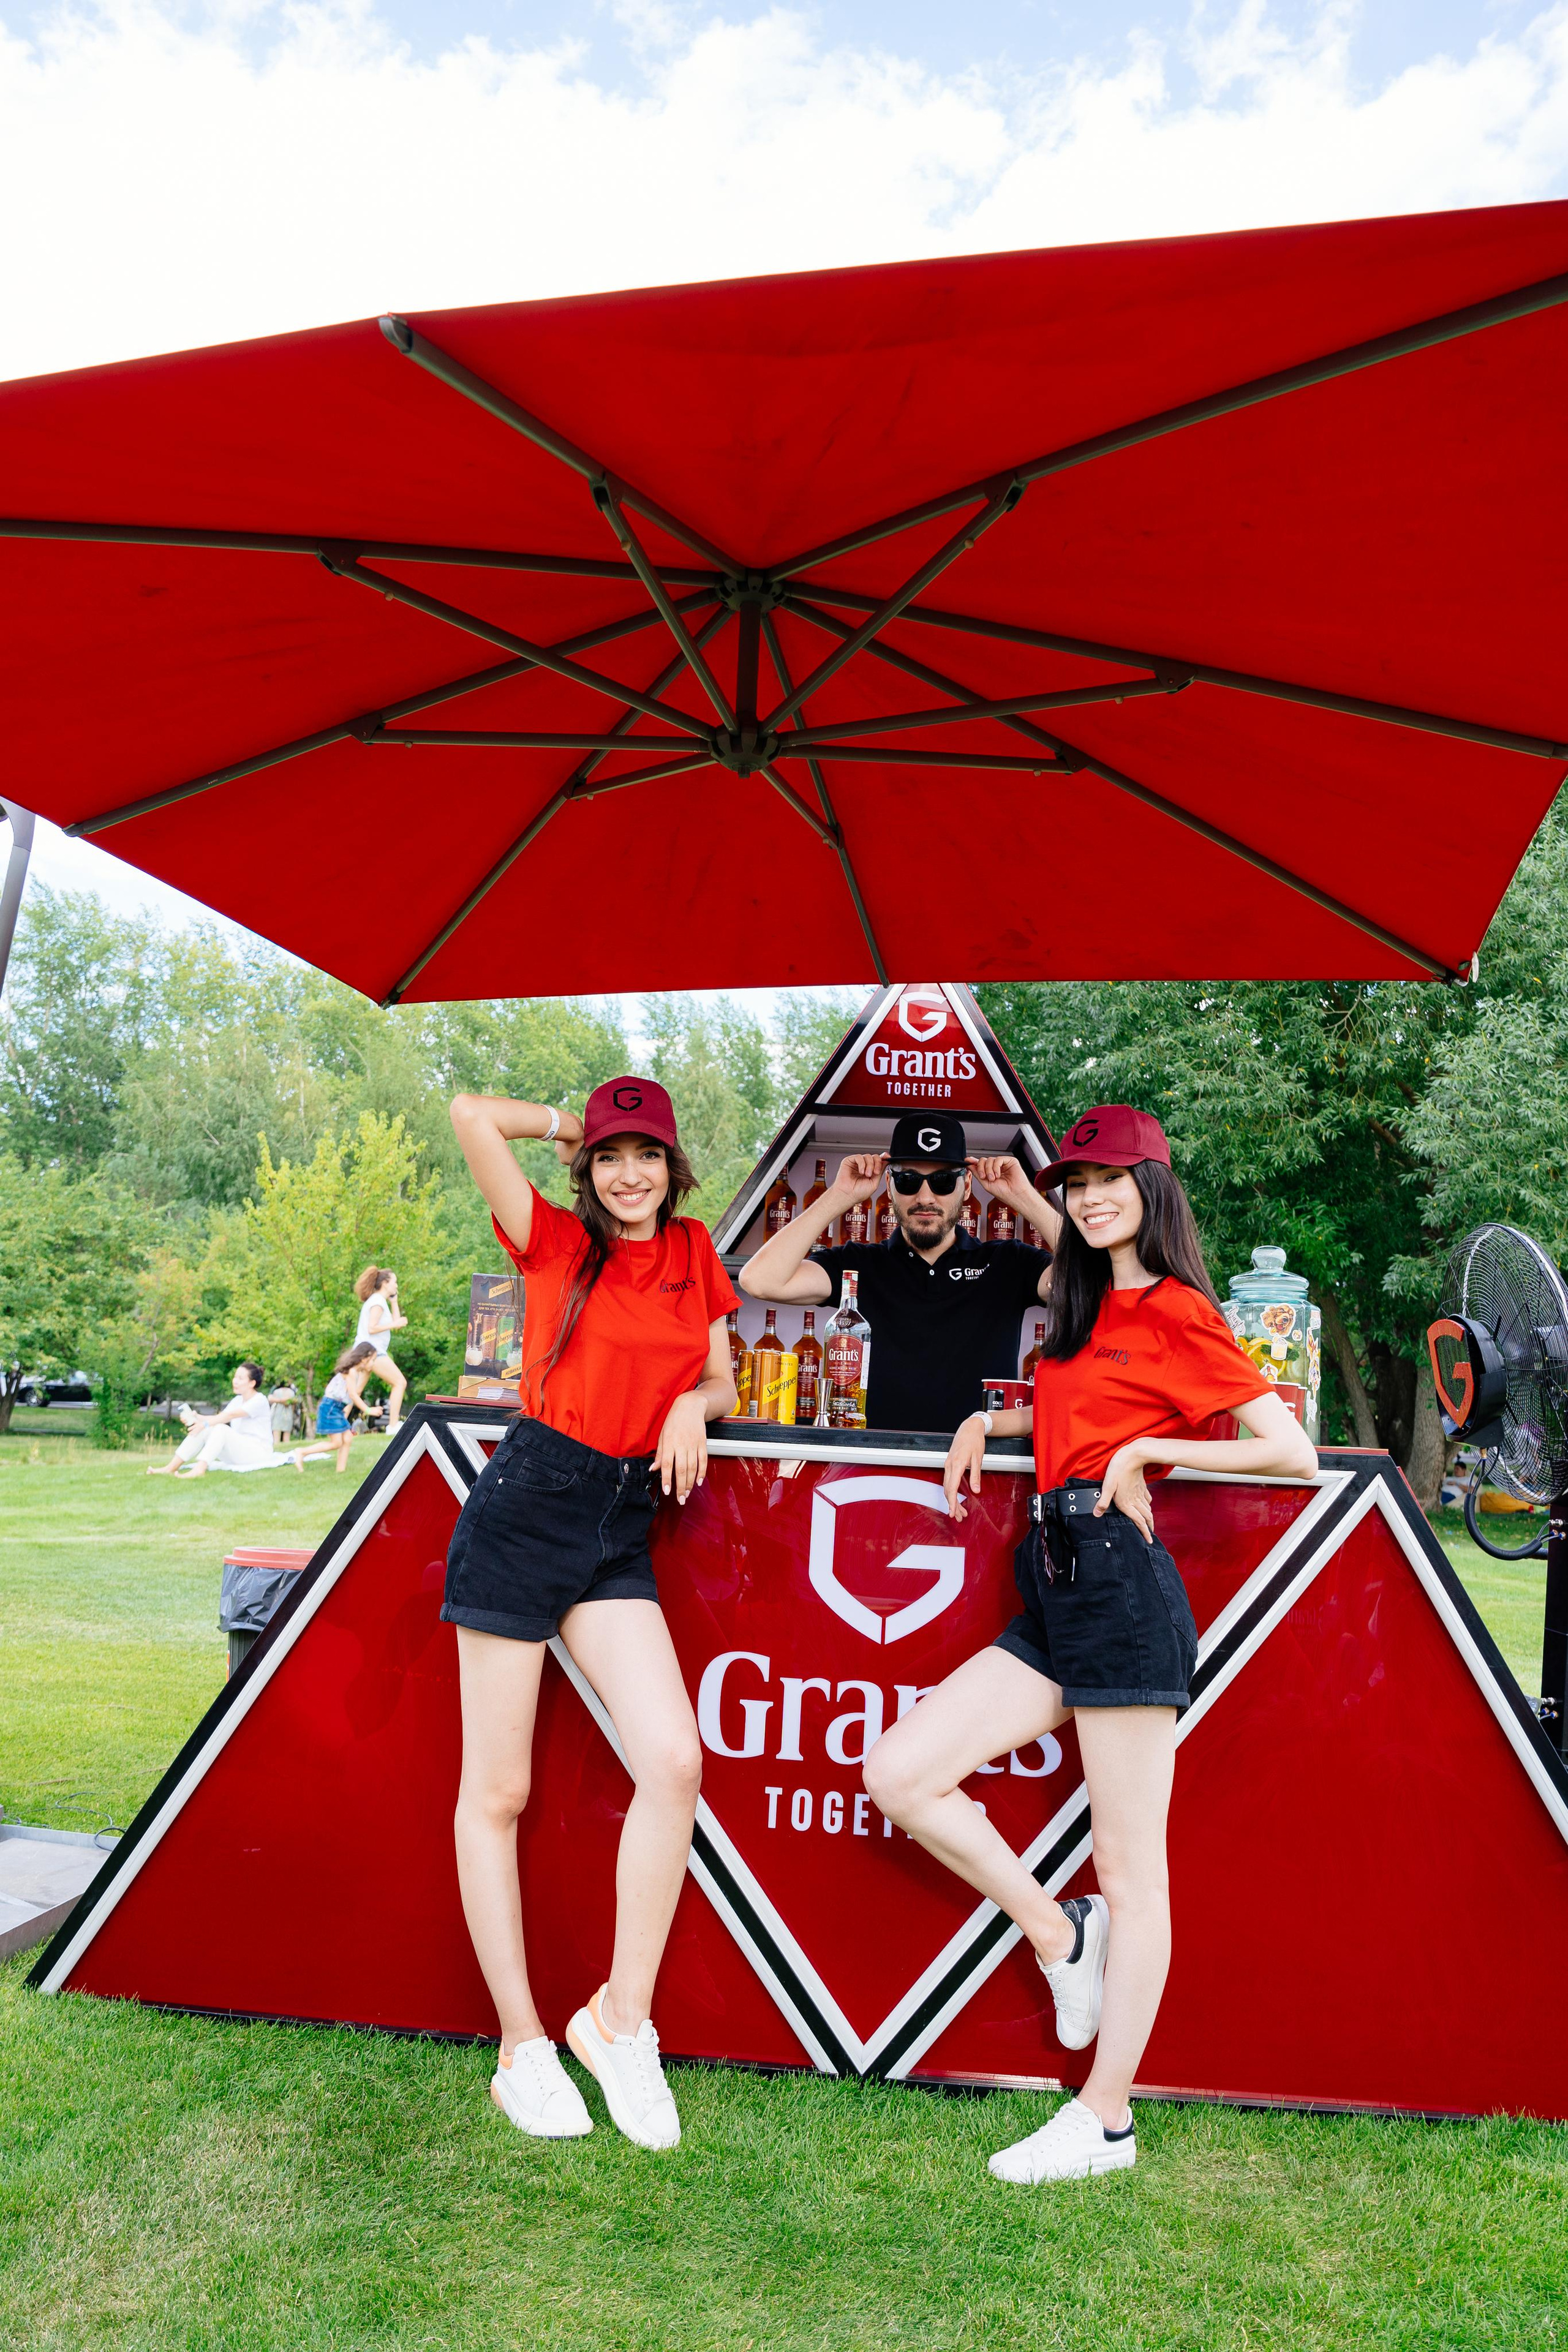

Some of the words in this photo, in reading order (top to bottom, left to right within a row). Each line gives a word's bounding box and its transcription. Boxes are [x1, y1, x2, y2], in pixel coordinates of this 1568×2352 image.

[865, 1042, 976, 1080] Grant's
[887, 1082, 951, 1097] TOGETHER
[613, 1087, 643, 1112] G
[918, 1128, 941, 1152] G
[1072, 1119, 1100, 1147] G
[769, 1209, 790, 1219] Grant's
[845, 1213, 867, 1223] Grant's
[881, 1215, 897, 1223] Gran
[993, 1219, 1014, 1229] Grant's
[829, 1349, 859, 1362] Grant's
[1094, 1346, 1131, 1365] Grant's
[797, 1364, 818, 1373] Grant's
